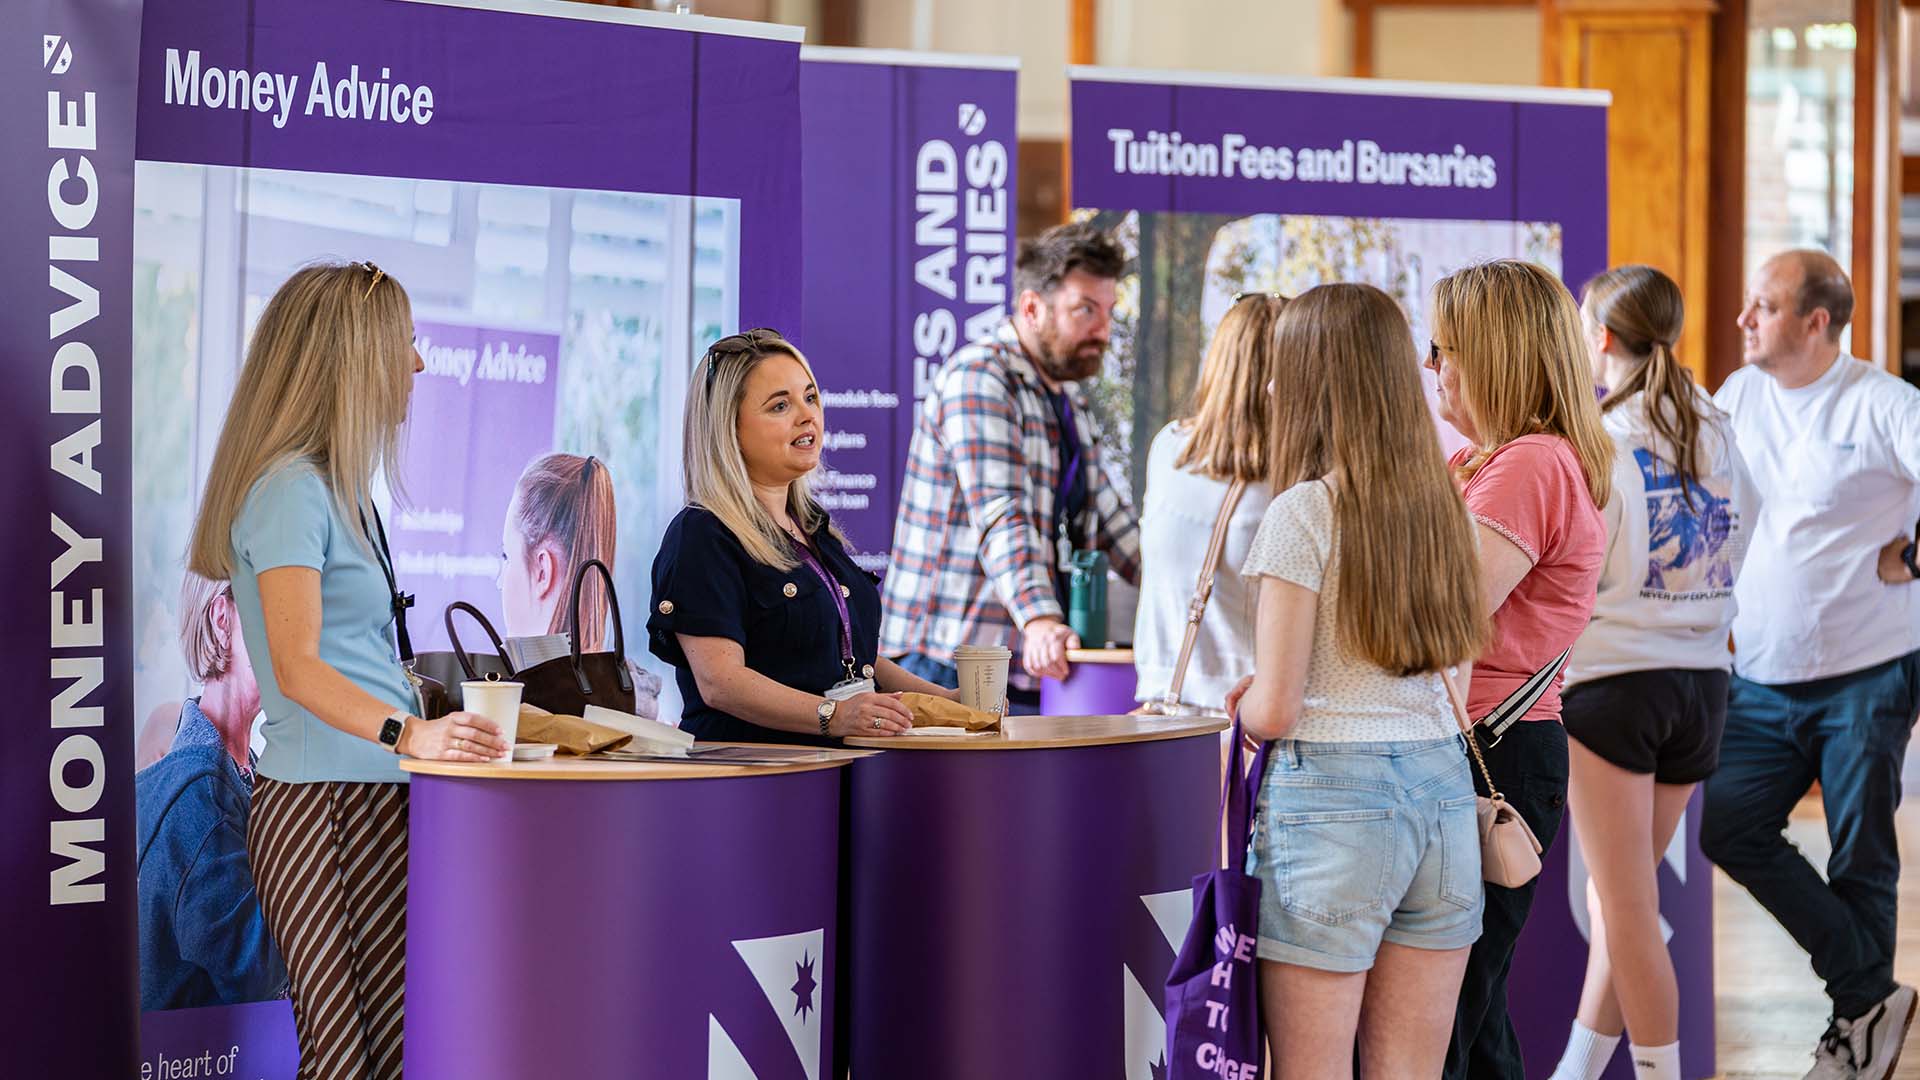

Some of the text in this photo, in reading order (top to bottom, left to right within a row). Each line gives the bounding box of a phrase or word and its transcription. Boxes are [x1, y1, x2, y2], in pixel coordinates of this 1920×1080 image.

[164, 47, 434, 129] Money Advice
[1107, 128, 1497, 189] Tuition Fees and Bursaries
[914, 138, 958, 301] AND
[964, 140, 1007, 345] ARIES
[476, 341, 547, 384] Advice
[47, 91, 105, 905] MONEY ADVICE
[1214, 923, 1256, 963] WE
[158, 1049, 212, 1080] heart
[216, 1045, 239, 1075] of
